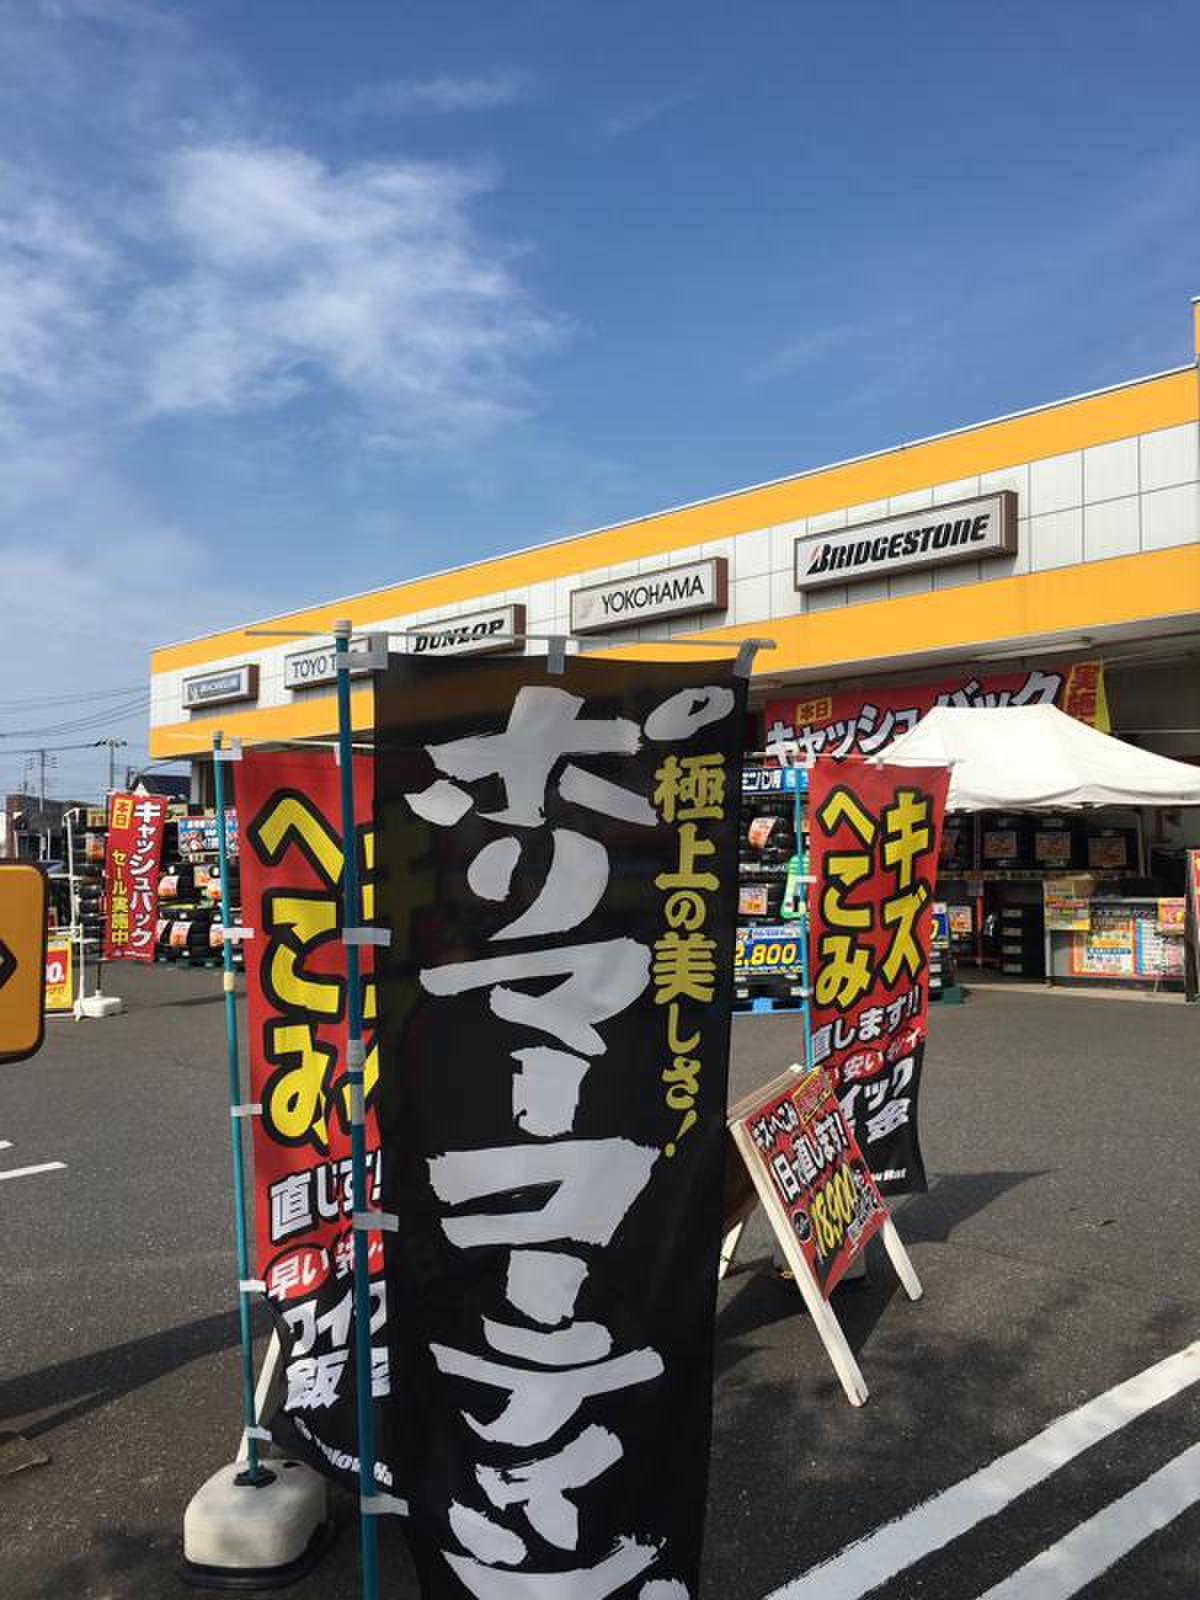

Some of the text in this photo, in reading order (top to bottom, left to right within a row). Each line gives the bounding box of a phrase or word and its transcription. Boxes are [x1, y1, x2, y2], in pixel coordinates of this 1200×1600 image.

[601, 574, 705, 615] YOKOHAMA
[807, 513, 990, 575] BRIDGESTONE
[291, 654, 326, 678] TOYO
[413, 619, 504, 652] DUNLOP
[129, 801, 161, 946] キャッシュバック
[815, 791, 875, 1008] へこみ
[882, 792, 929, 983] キズ
[403, 685, 735, 1600] ポリマーコーティン
